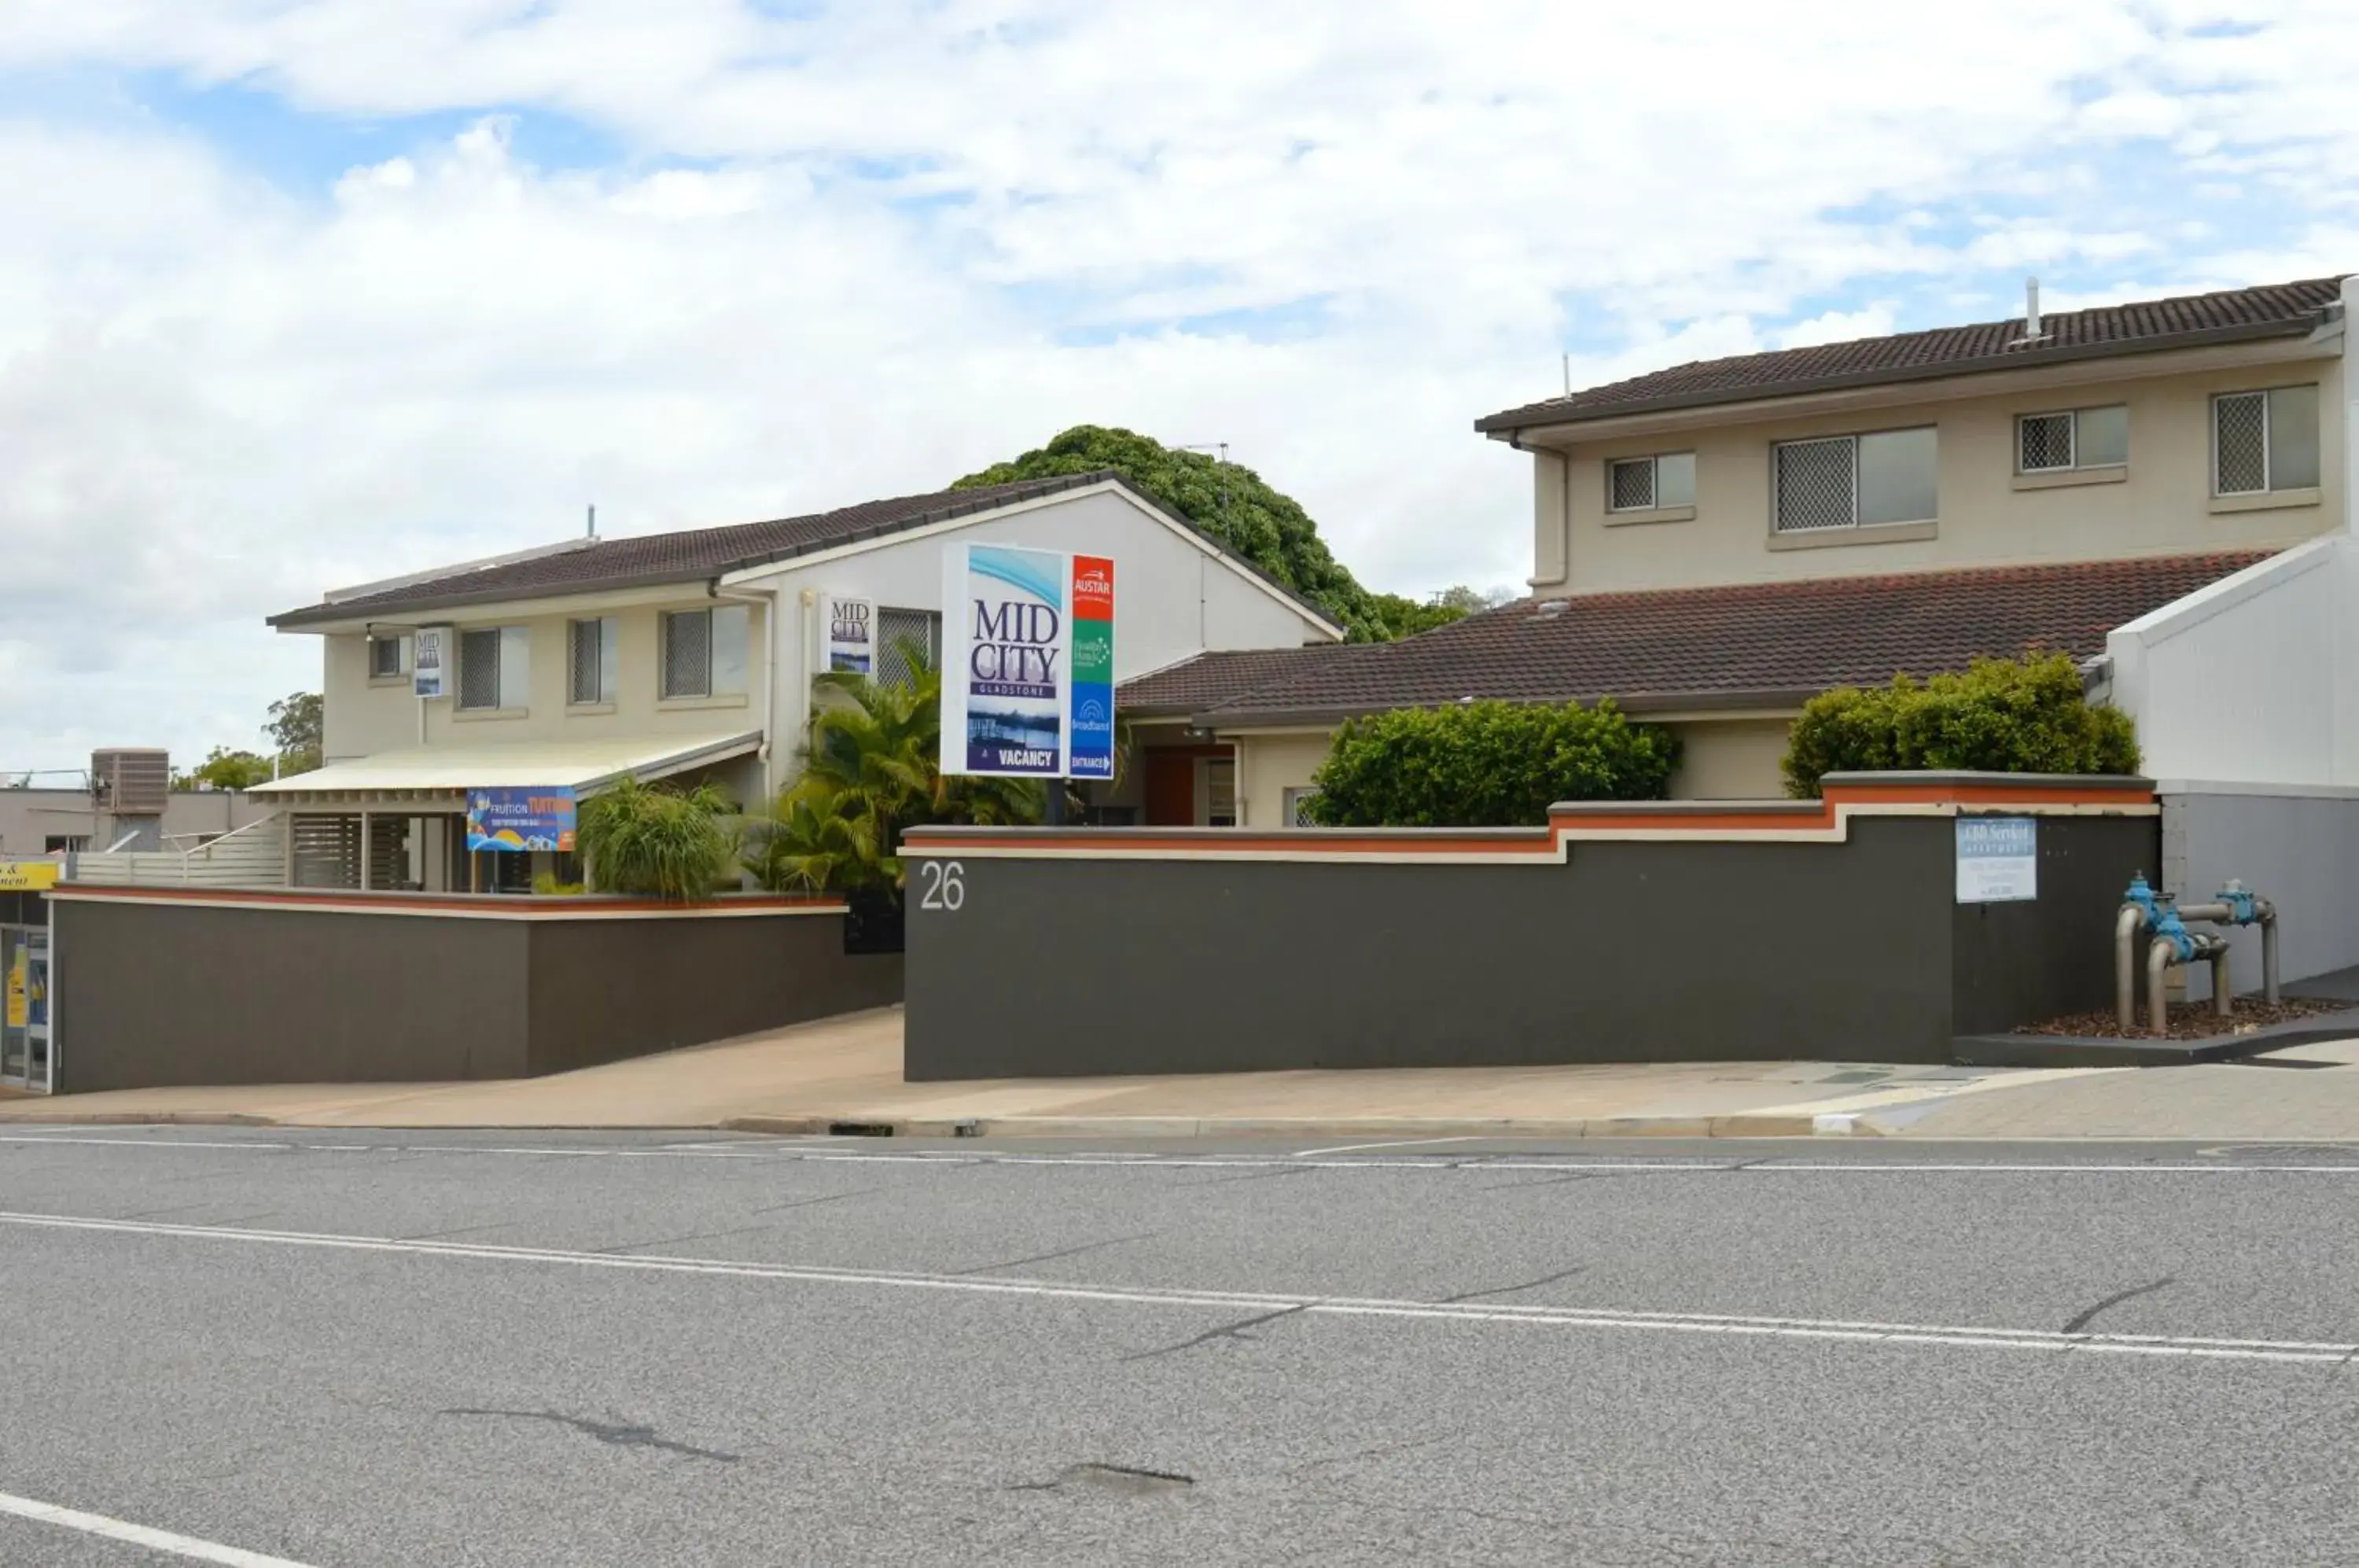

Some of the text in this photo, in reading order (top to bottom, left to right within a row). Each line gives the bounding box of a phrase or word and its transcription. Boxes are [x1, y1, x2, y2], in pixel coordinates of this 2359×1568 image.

[1075, 578, 1110, 594] AUSTAR
[832, 602, 869, 620] MID
[831, 619, 869, 636] CITY
[973, 598, 1058, 644] MID
[971, 643, 1060, 683] CITY
[979, 683, 1044, 696] GLADSTONE
[998, 749, 1053, 767] VACANCY
[490, 804, 528, 815] FRUITION
[921, 860, 964, 910] 26
